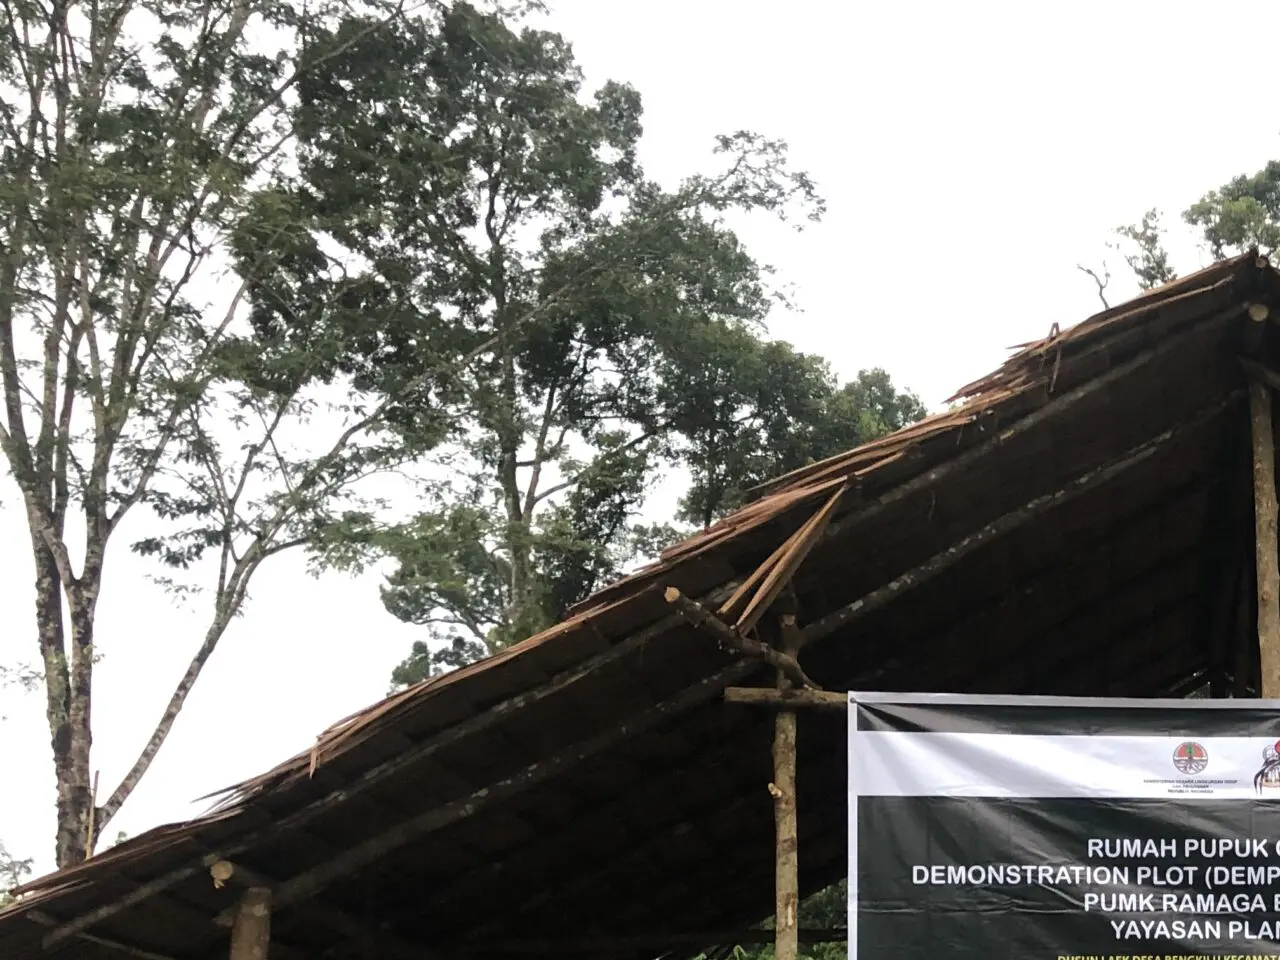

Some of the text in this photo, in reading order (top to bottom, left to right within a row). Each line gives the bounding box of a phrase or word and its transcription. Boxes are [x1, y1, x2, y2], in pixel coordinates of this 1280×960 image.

[1088, 839, 1177, 857] RUMAH
[1184, 839, 1268, 857] PUPUK
[913, 866, 1128, 885] DEMONSTRATION
[1137, 866, 1198, 885] PLOT
[1084, 893, 1155, 912] PUMK
[1162, 893, 1266, 912] RAMAGA
[1111, 921, 1221, 939] YAYASAN
